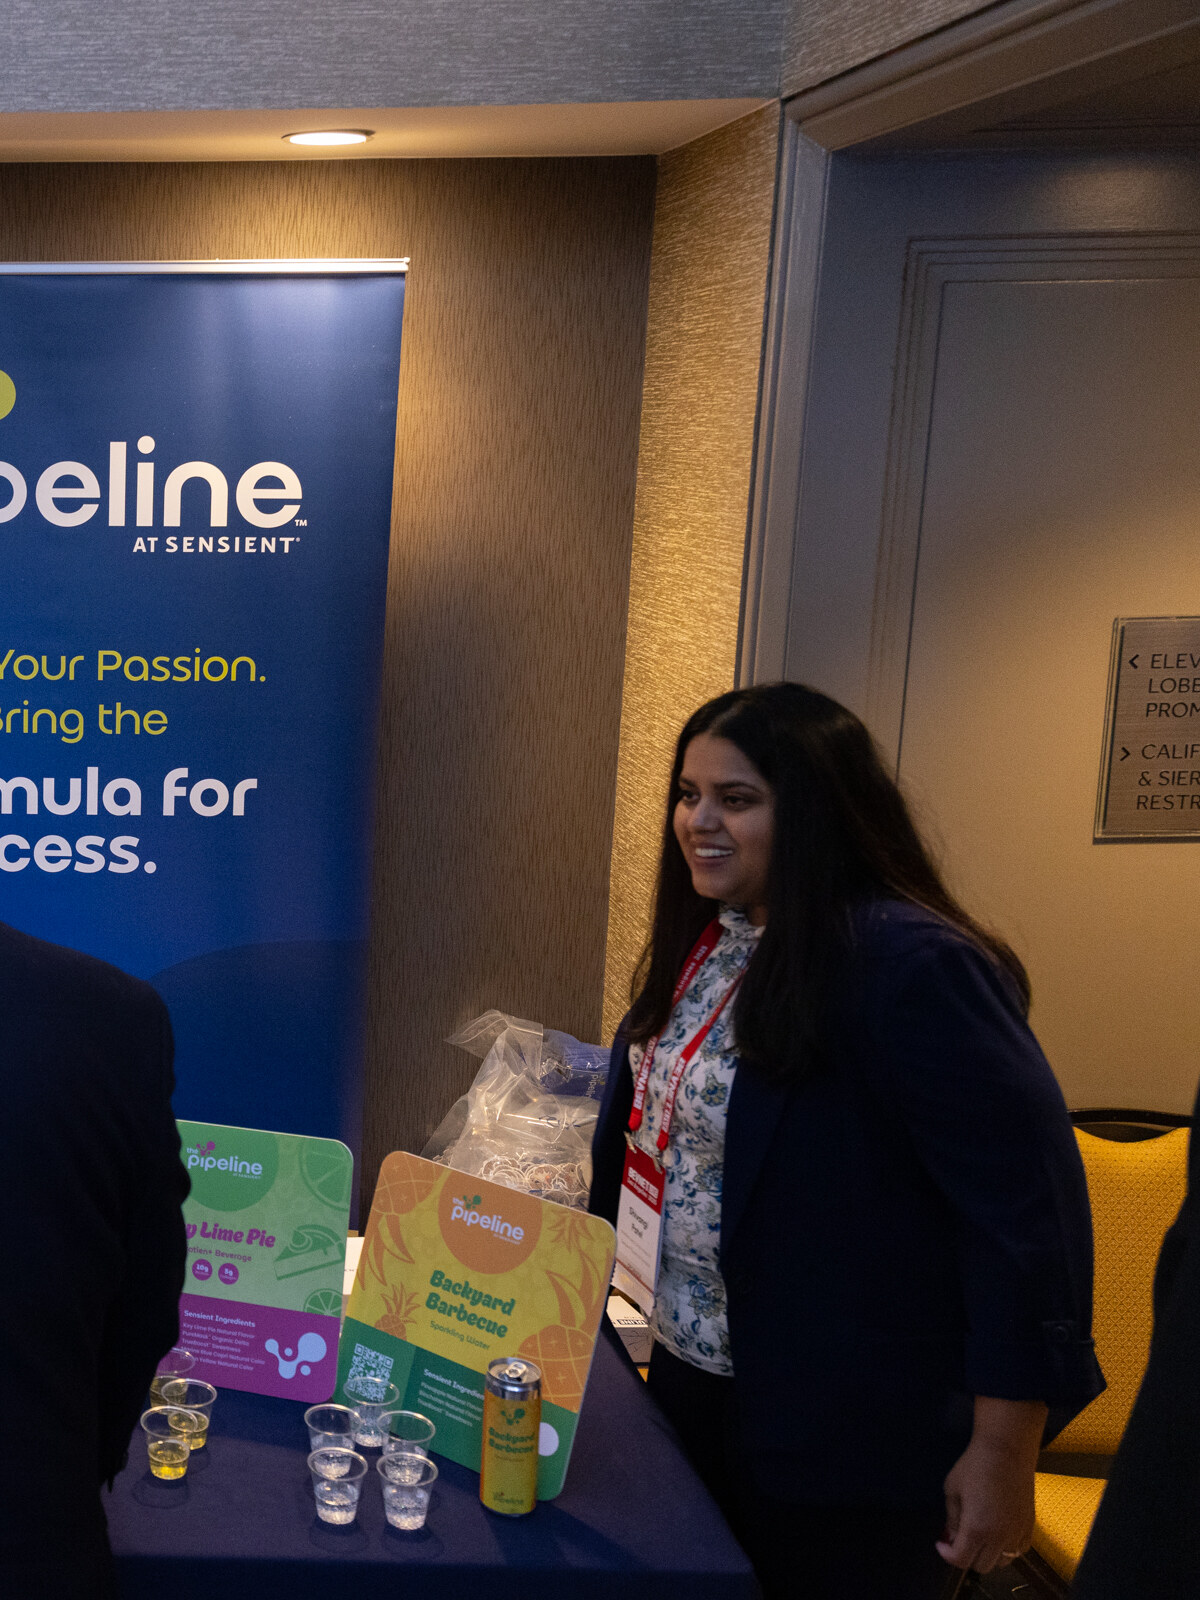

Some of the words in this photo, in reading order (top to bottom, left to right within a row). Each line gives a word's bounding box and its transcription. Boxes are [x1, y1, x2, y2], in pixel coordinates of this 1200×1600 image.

[133, 537, 158, 553] AT
[97, 647, 267, 682] Passion.
[99, 702, 169, 735] the
[162, 767, 258, 817] for
[1138, 770, 1152, 787] &
[186, 1147, 199, 1155] the
[452, 1197, 465, 1206] the
[200, 1221, 244, 1243] Lime
[246, 1228, 276, 1248] Pie
[450, 1205, 525, 1241] pipeline
[196, 1263, 209, 1273] 10g
[224, 1267, 234, 1277] 5g
[429, 1269, 516, 1316] Backyard
[183, 1309, 214, 1321] Sensient
[215, 1314, 256, 1328] Ingredients
[425, 1292, 508, 1338] Barbecue
[430, 1320, 465, 1342] Sparkling
[466, 1334, 490, 1350] Water
[423, 1368, 451, 1386] Sensient
